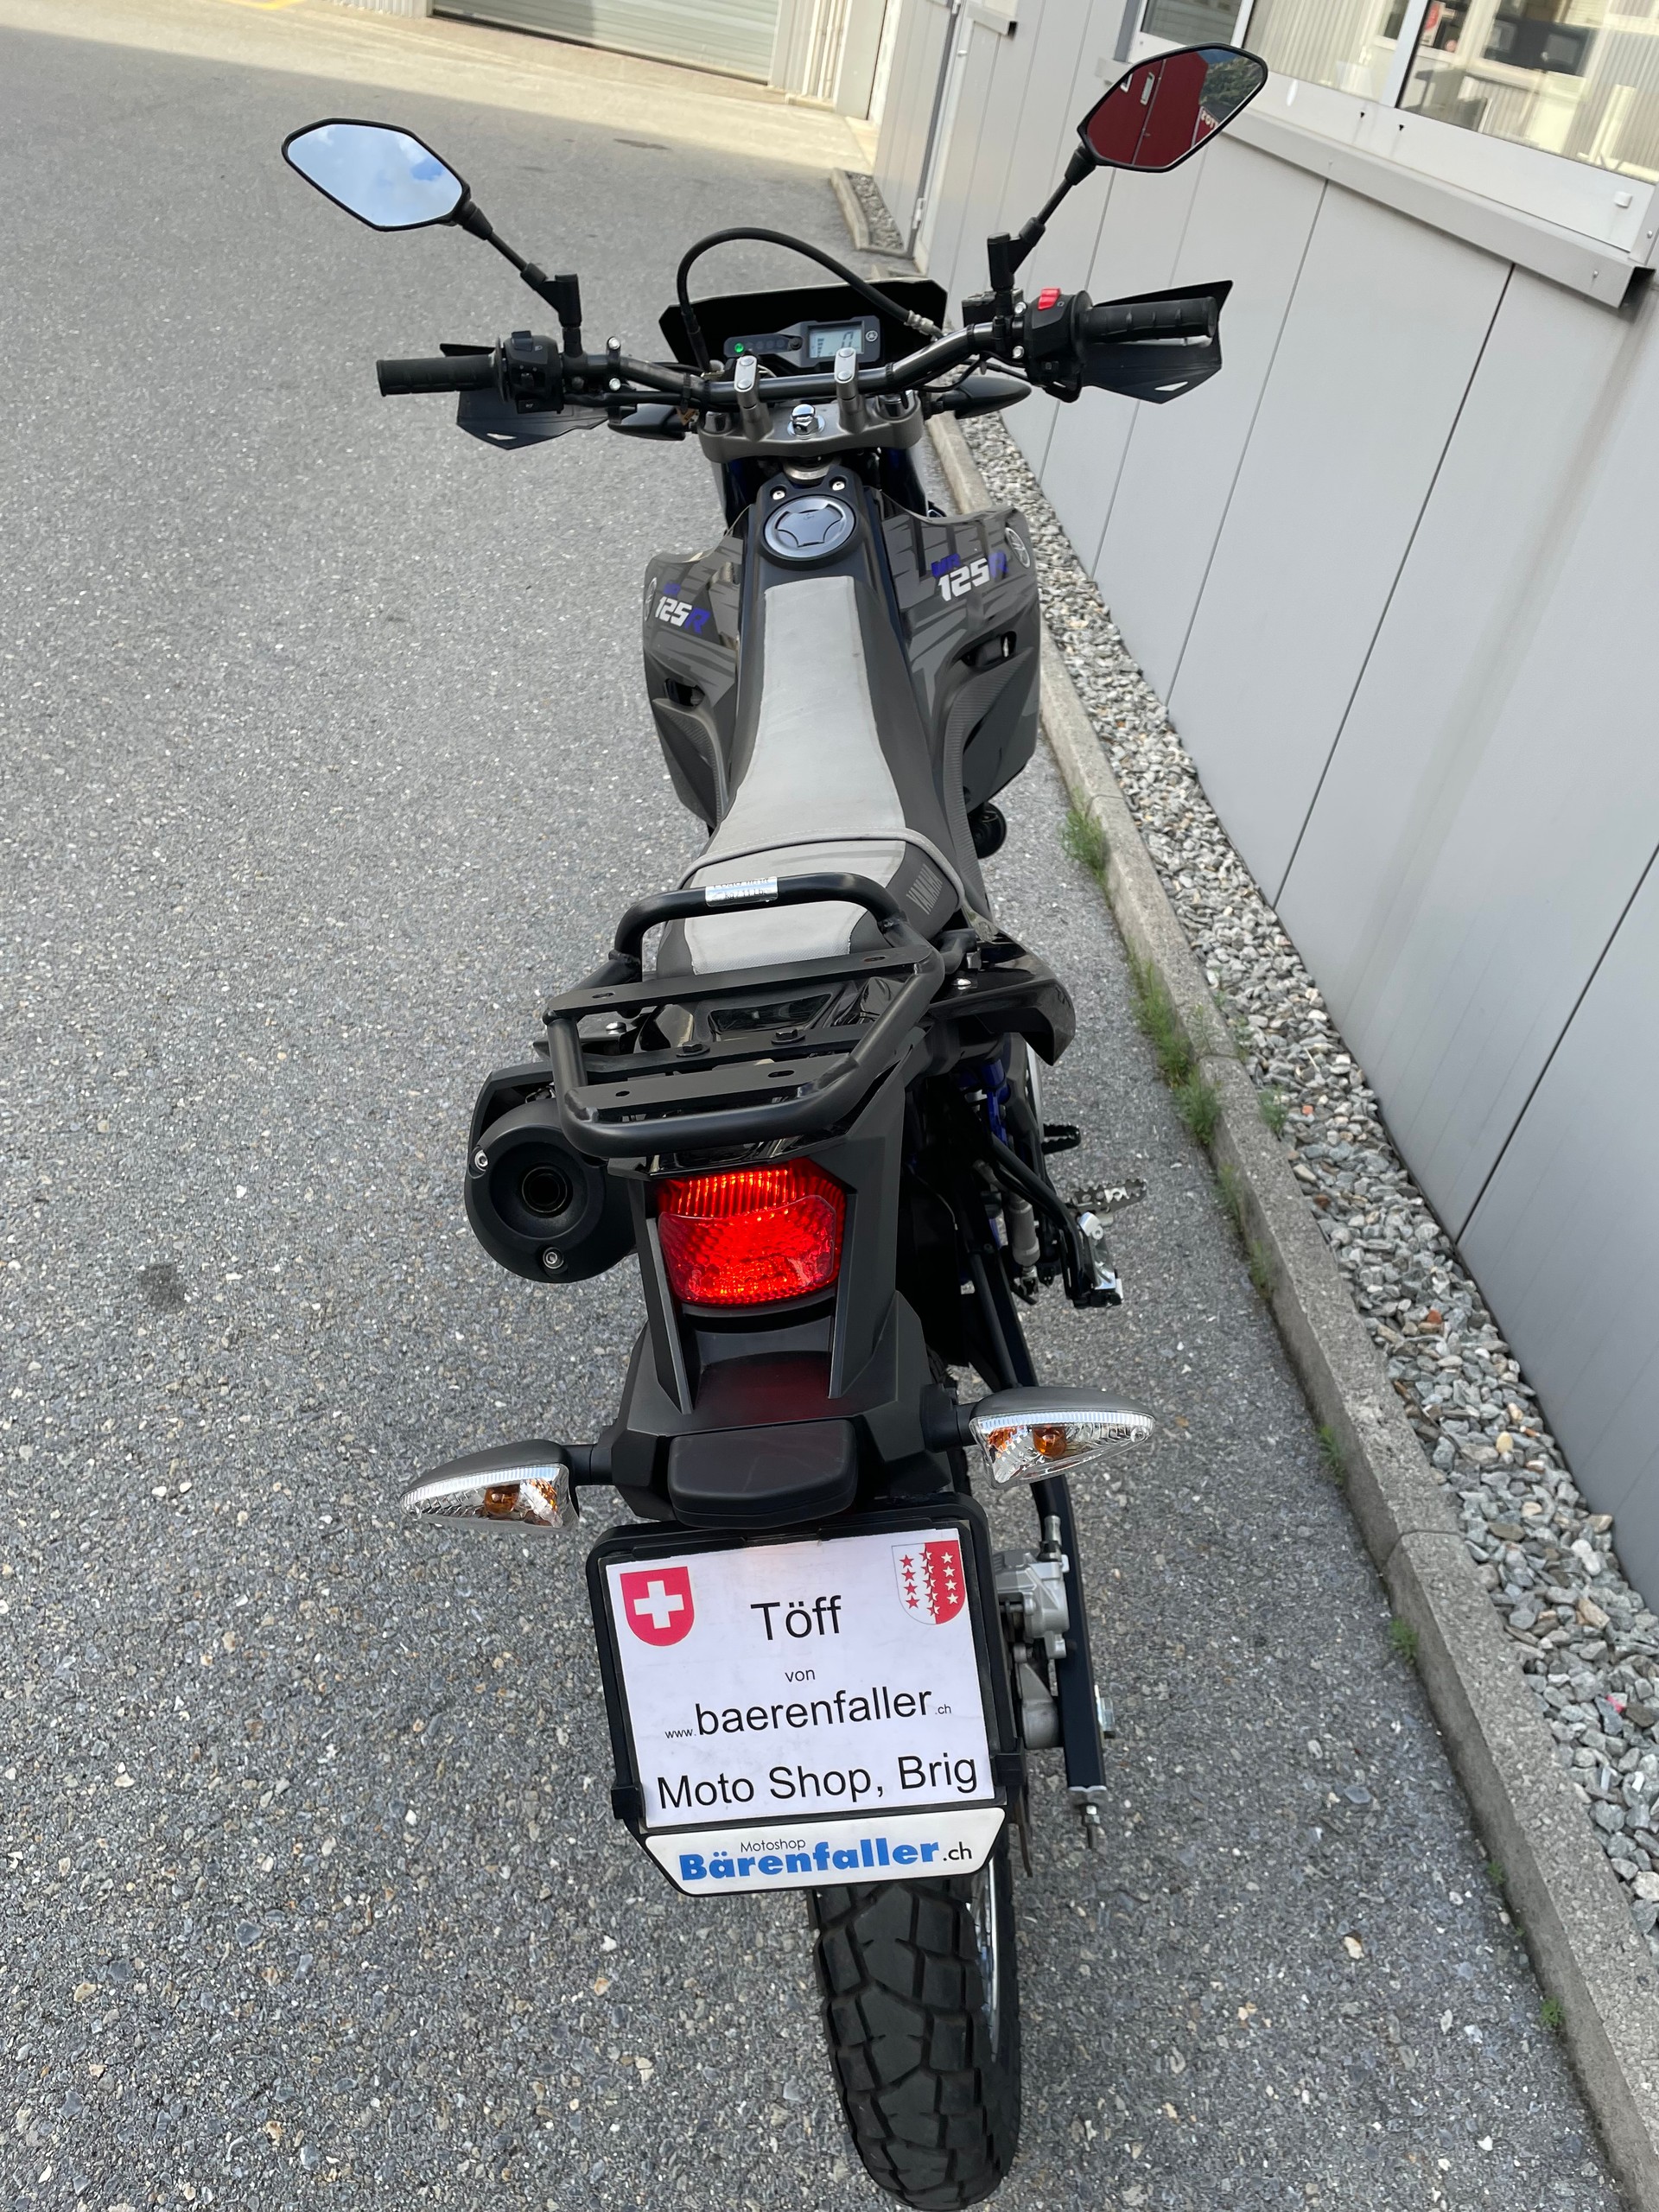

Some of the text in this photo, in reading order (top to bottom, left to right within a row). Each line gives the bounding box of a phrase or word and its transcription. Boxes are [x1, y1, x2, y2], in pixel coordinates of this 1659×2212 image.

[938, 550, 1009, 601] 125R
[655, 596, 710, 634] 125R
[906, 863, 943, 915] YAMAHA
[751, 1595, 842, 1641] Töff
[785, 1669, 816, 1682] von
[658, 1752, 977, 1809] Moto Shop, Brig
[679, 1838, 973, 1881] Bärenfaller.ch
[741, 1839, 806, 1853] Motoshop
